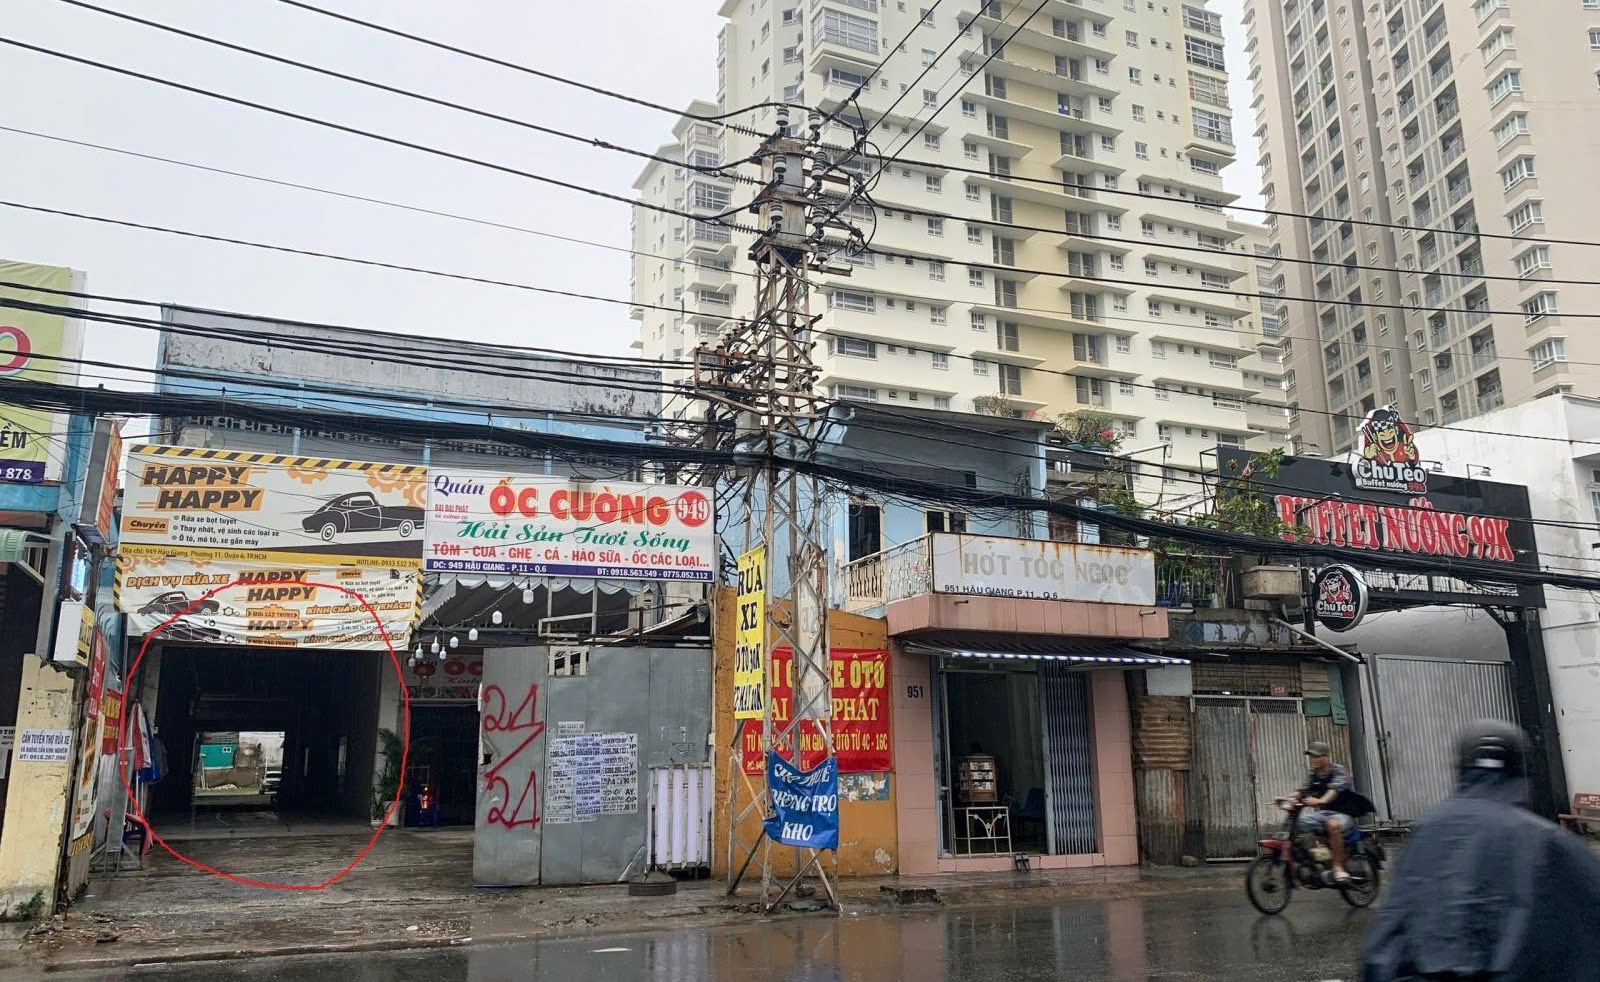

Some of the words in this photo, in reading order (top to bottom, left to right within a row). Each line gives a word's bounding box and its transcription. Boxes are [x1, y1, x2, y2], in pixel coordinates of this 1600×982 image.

[6, 467, 32, 480] 878
[143, 466, 249, 485] HAPPY
[1359, 460, 1394, 480] Chú
[1393, 462, 1425, 482] Tèo
[1362, 479, 1386, 487] Buffet
[157, 489, 264, 509] HAPPY
[434, 475, 485, 497] Quán
[489, 476, 538, 518] ỐC
[549, 486, 672, 527] CƯỜNG
[676, 497, 709, 520] 949
[180, 525, 196, 534] Thay
[227, 527, 242, 535] sinh
[456, 521, 510, 540] Hải
[515, 523, 566, 542] Sản
[573, 526, 628, 545] Tươi
[633, 530, 691, 552] Sống
[1467, 516, 1514, 561] 99K
[245, 537, 259, 547] máy
[432, 541, 460, 556] TÔM
[472, 546, 496, 557] CUA
[508, 547, 532, 561] GHẸ
[544, 547, 560, 560] CÁ
[572, 548, 596, 562] HÀO
[599, 550, 620, 563] SỮA
[632, 550, 647, 564] ỐC
[651, 551, 672, 566] CÁC
[433, 561, 446, 569] ĐC:
[448, 561, 463, 569] 949
[465, 561, 481, 571] HẬU
[482, 563, 505, 571] GIANG
[511, 564, 528, 573] P.11
[534, 565, 547, 573] Q.6
[610, 568, 657, 578] 0918.563.549
[663, 571, 708, 579] 0775.052.112
[127, 576, 160, 589] DỊCH
[161, 575, 181, 588] VỤ
[209, 573, 230, 584] XE
[238, 571, 306, 585] HAPPY
[737, 557, 763, 597] RỬA
[247, 587, 315, 601] HAPPY
[944, 584, 960, 592] 951
[985, 587, 1014, 597] GIANG
[1016, 590, 1034, 599] P.11
[248, 620, 313, 630] HAPPY
[740, 601, 758, 632] XE
[849, 653, 885, 689] ÔTÔ
[907, 685, 924, 698] 951
[746, 730, 757, 752] TỪ
[811, 794, 837, 817] TRỌ
[781, 821, 814, 841] KHO
